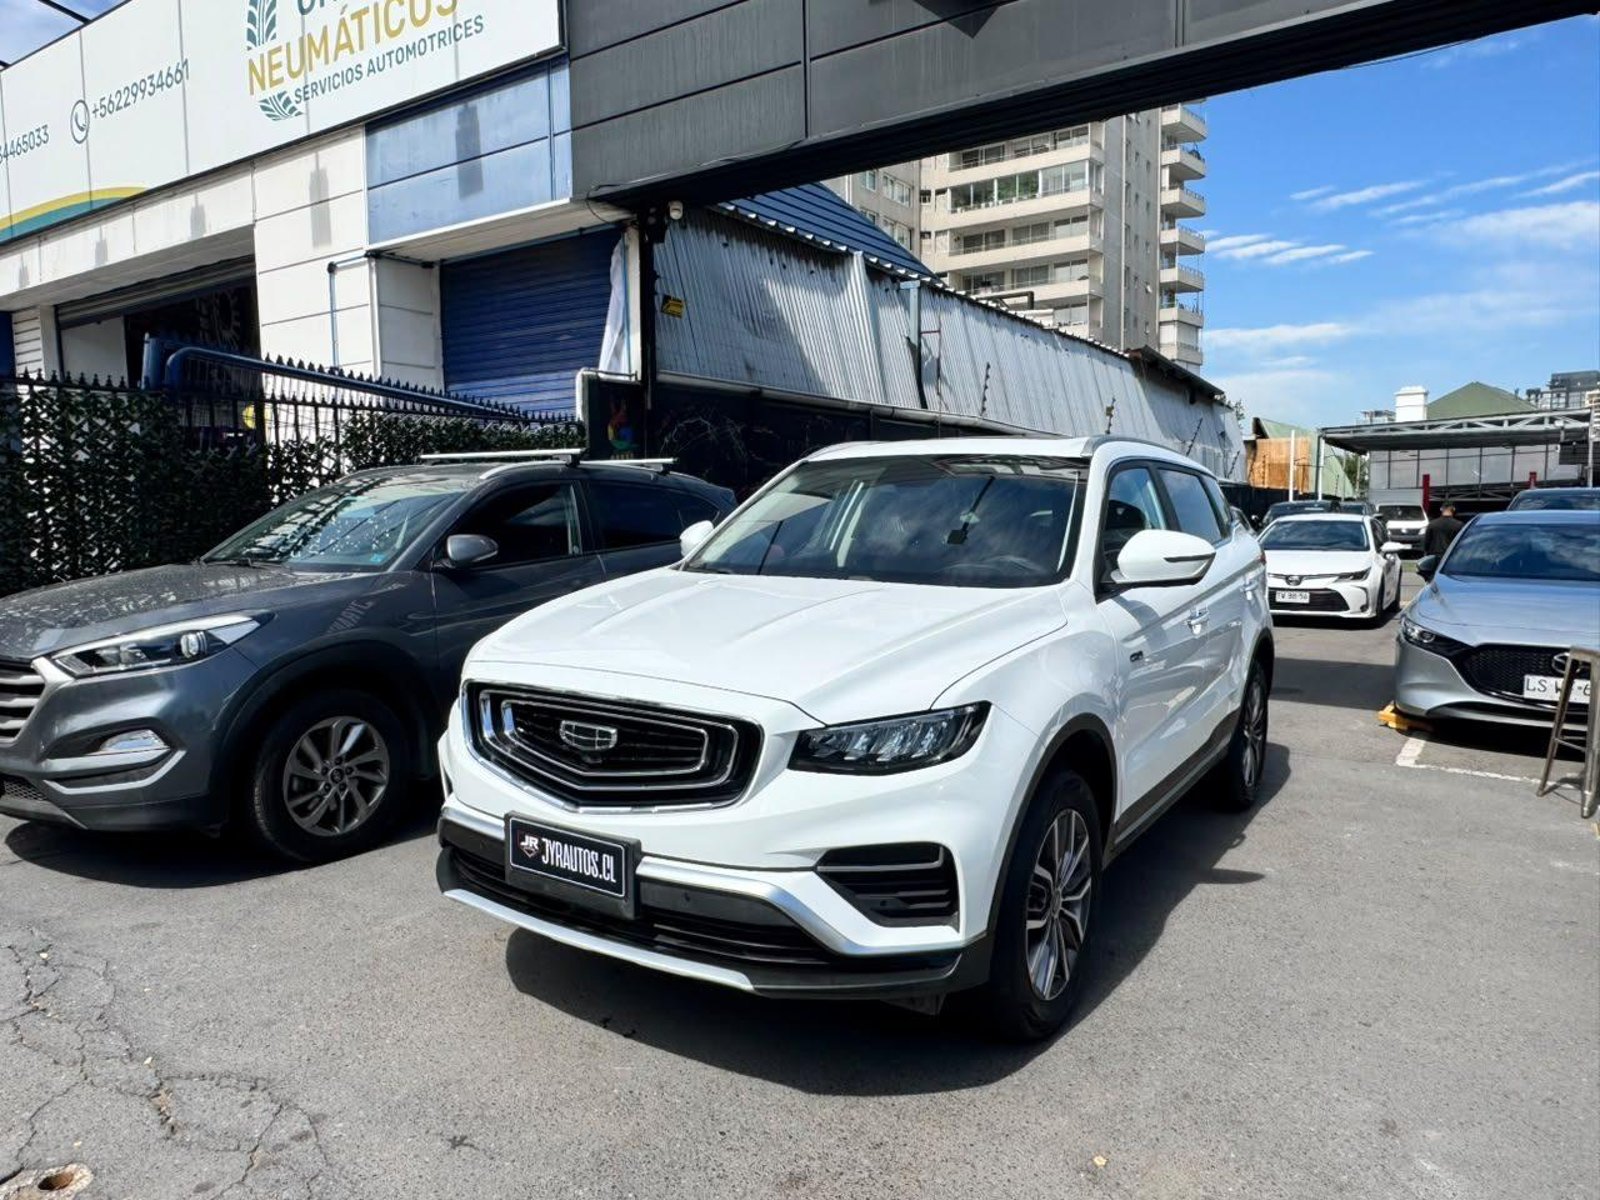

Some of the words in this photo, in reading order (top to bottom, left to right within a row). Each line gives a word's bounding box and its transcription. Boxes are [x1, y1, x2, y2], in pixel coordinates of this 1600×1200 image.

[92, 58, 189, 118] +56229934661
[294, 64, 363, 104] SERVICIOS
[367, 15, 484, 77] AUTOMOTRICES
[541, 838, 617, 883] JYRAUTOS.CL
